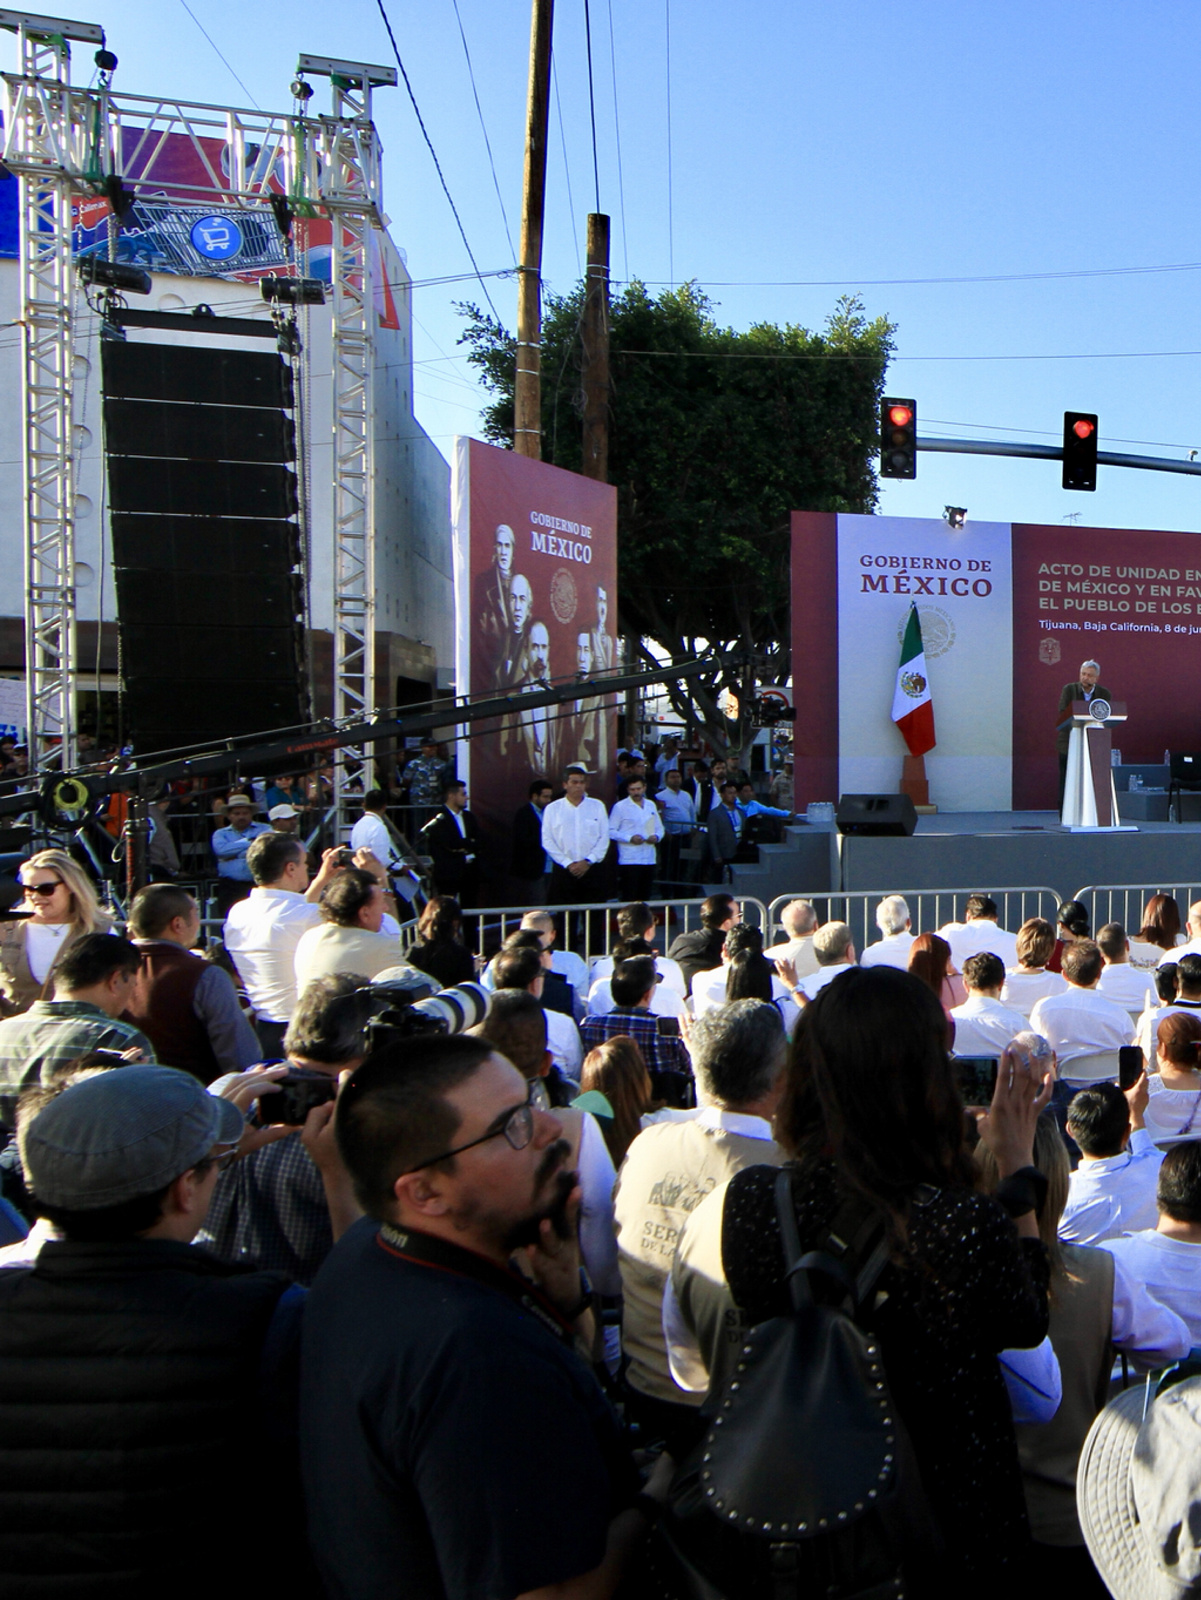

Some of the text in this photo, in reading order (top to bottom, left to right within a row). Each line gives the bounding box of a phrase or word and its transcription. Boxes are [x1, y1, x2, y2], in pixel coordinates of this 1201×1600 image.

[530, 511, 592, 539] GOBIERNO DE
[531, 529, 592, 564] MÉXICO
[860, 554, 992, 572] GOBIERNO DE
[1038, 563, 1084, 576] ACTO
[1089, 565, 1111, 577] DE
[1116, 567, 1180, 580] UNIDAD
[860, 569, 992, 597] MÉXICO
[1038, 580, 1062, 592] DE
[1067, 579, 1130, 595] MÉXICO
[1135, 584, 1145, 596] Y
[1150, 585, 1171, 597] EN
[1039, 597, 1059, 610] EL
[1064, 598, 1130, 612] PUEBLO
[1135, 601, 1157, 613] DE
[1162, 602, 1192, 615] LOS
[1038, 619, 1081, 631] Tijuana,
[1084, 621, 1107, 632] Baja
[1110, 622, 1162, 634] California,
[1164, 624, 1171, 633] 8
[1174, 624, 1187, 634] de
[643, 1220, 678, 1243] SER
